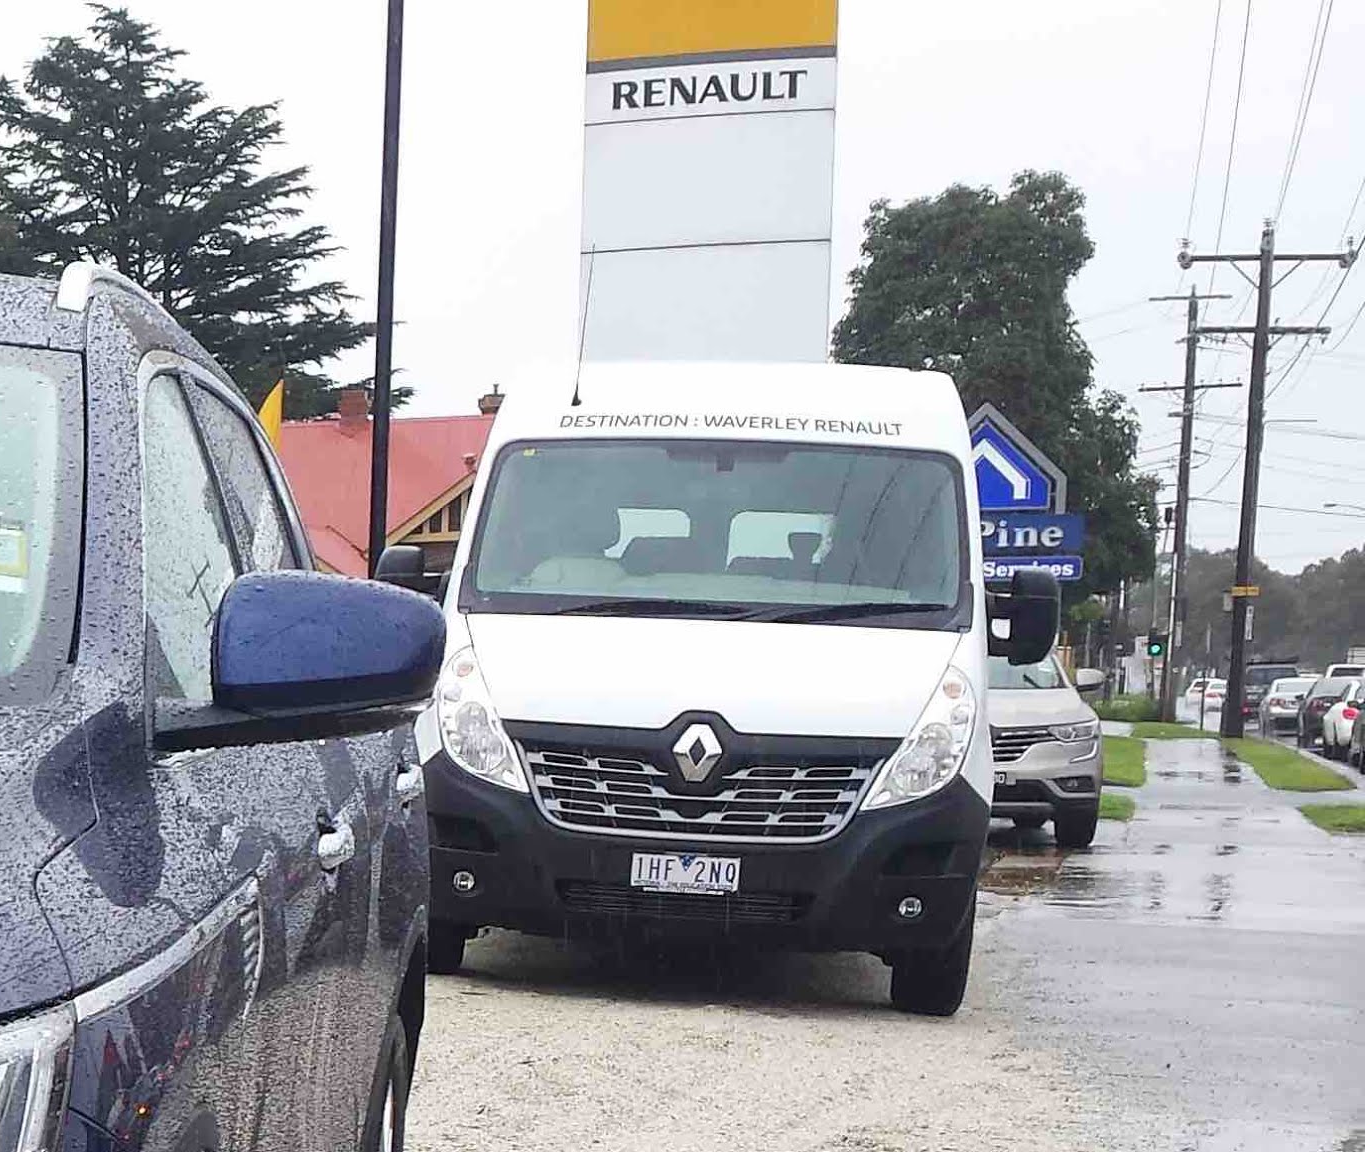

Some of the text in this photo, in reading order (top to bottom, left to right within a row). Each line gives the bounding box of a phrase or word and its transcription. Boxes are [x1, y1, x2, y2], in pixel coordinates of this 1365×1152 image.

[612, 70, 808, 110] RENAULT
[559, 414, 688, 429] DESTINATION
[704, 414, 810, 432] WAVERLEY
[815, 418, 904, 437] RENAULT
[637, 857, 677, 881] 1HF
